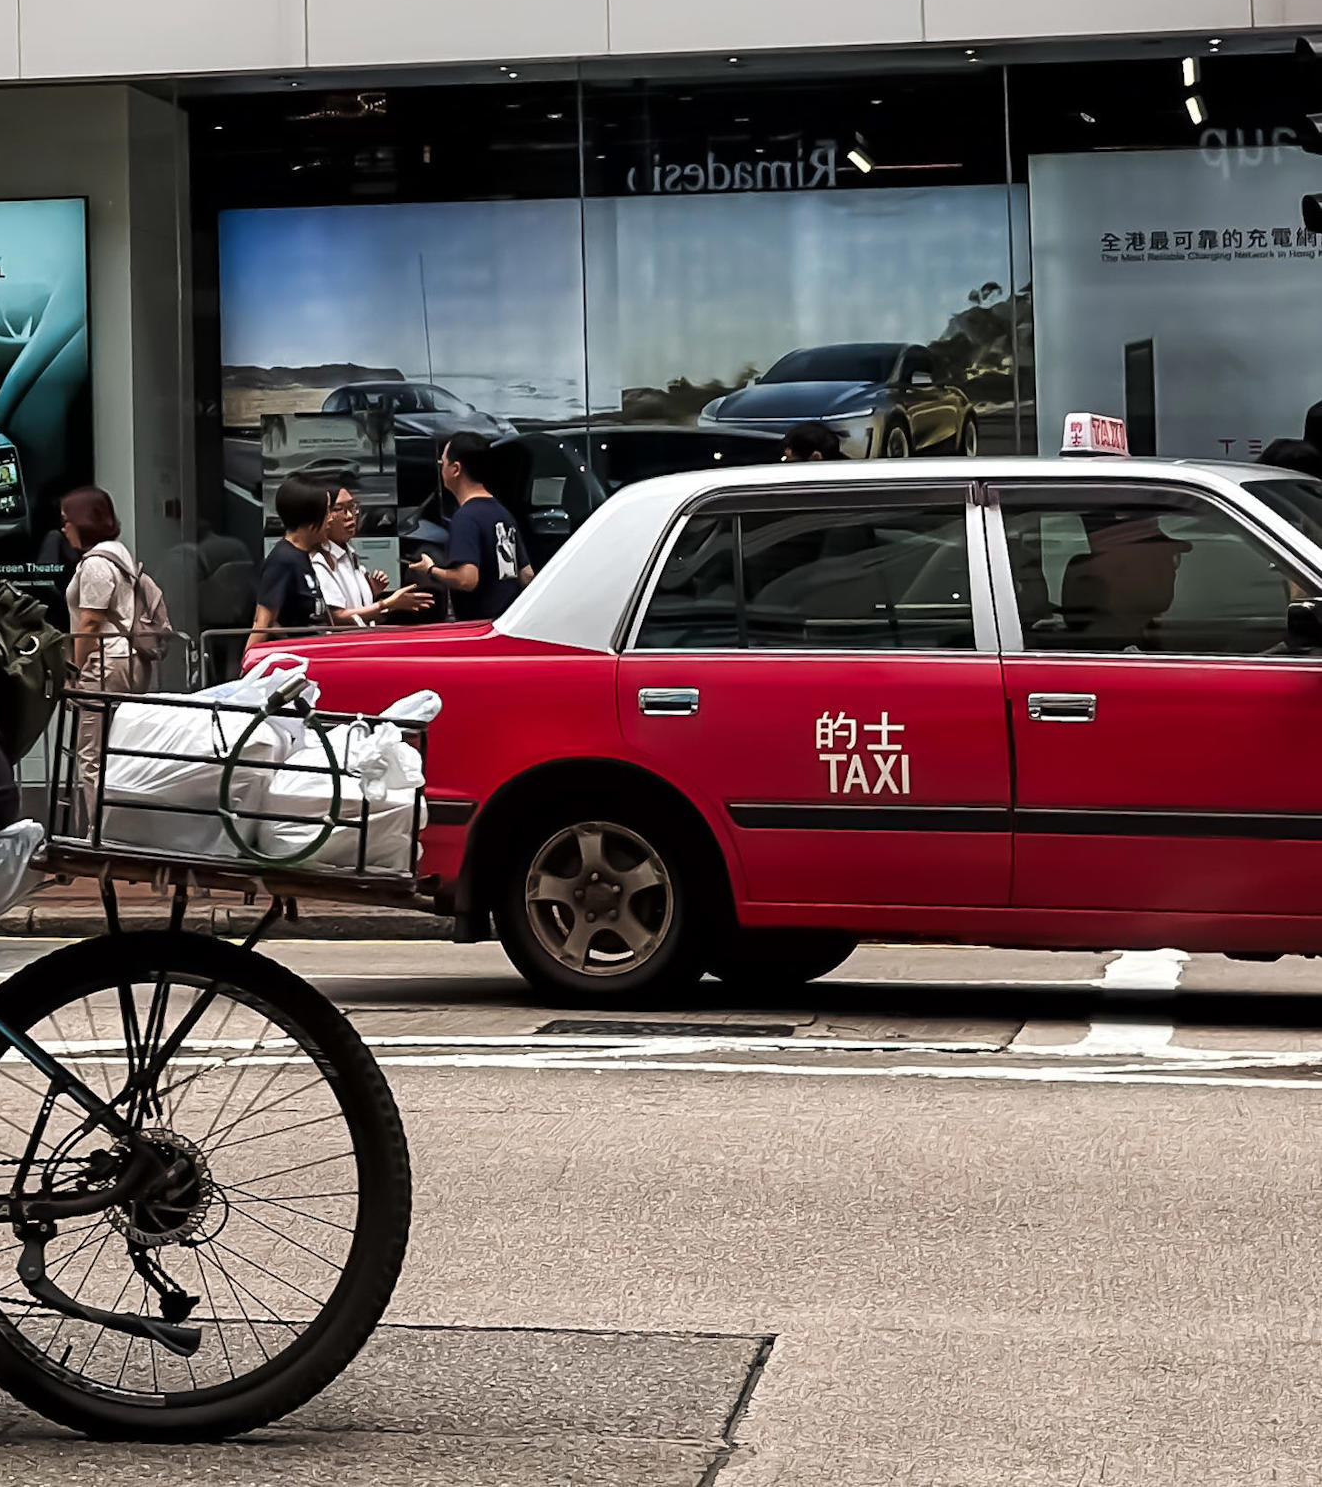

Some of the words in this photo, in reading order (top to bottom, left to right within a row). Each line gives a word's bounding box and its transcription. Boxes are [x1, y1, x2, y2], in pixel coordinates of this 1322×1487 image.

[1100, 227, 1322, 253] 全港最可靠的充電網
[1070, 421, 1083, 447] 的士
[1091, 417, 1126, 450] TAXI
[26, 562, 65, 573] Theater
[815, 711, 905, 751] 的士
[819, 753, 911, 794] TAXI
